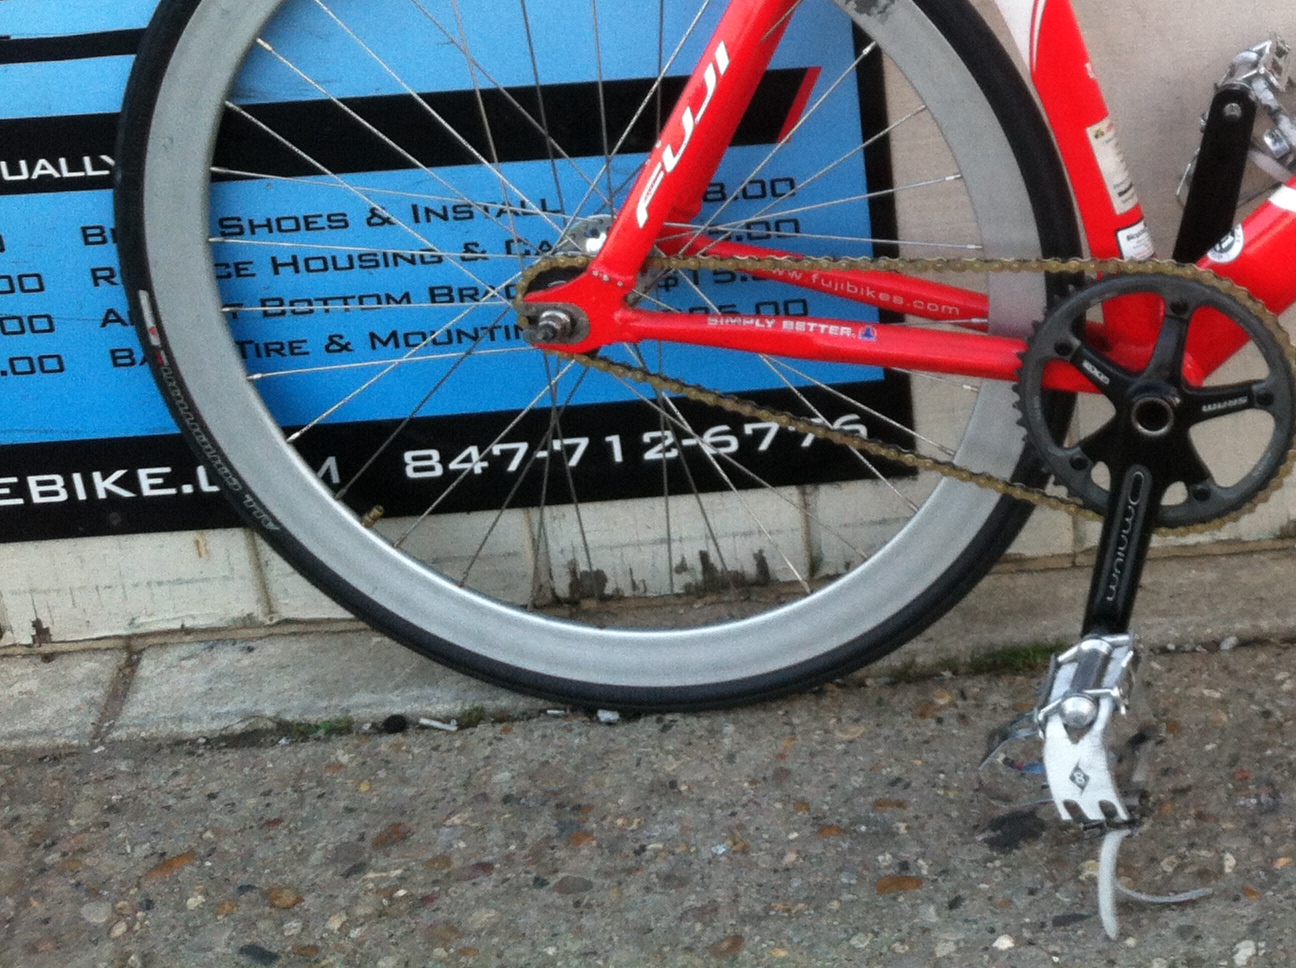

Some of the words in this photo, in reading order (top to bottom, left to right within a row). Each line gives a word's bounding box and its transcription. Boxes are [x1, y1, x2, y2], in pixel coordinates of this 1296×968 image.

[636, 40, 731, 229] FUJI
[219, 212, 349, 238] SHOES
[366, 206, 402, 227] &
[411, 197, 562, 224] INSTALL
[271, 253, 445, 276] HOUSING
[460, 241, 489, 262] &
[260, 293, 412, 318] BOTTOM
[325, 334, 354, 353] &
